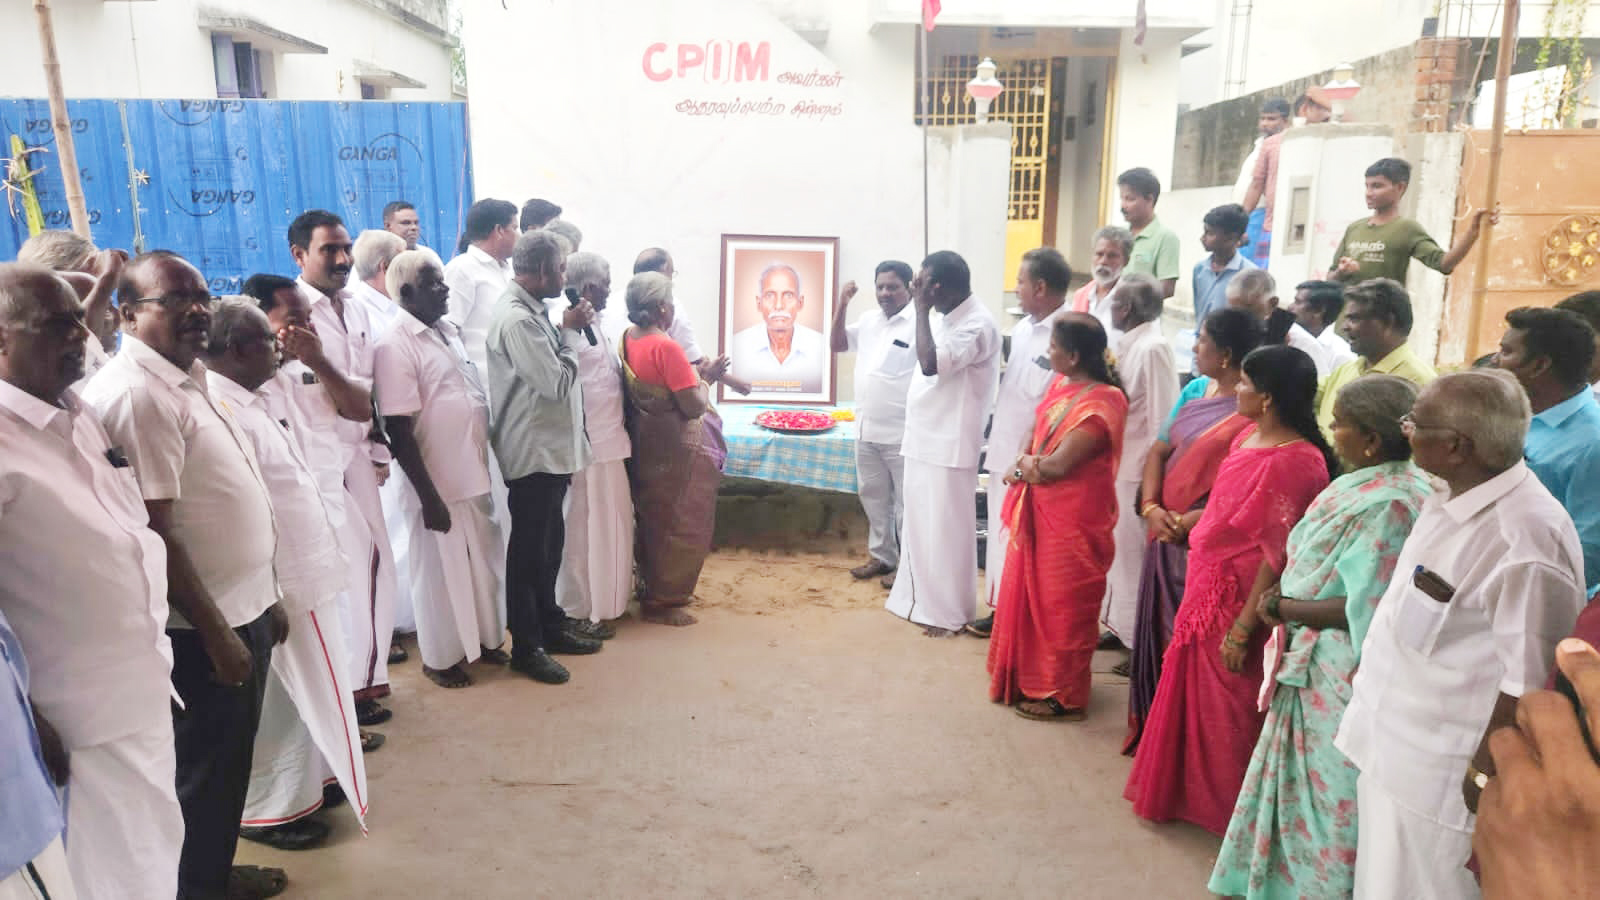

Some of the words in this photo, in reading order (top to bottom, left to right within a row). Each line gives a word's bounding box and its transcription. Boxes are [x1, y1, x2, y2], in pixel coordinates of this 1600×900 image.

[180, 99, 246, 113] GANGA
[25, 118, 89, 134] GGA
[338, 146, 398, 161] GANGA
[191, 189, 255, 205] GANGA
